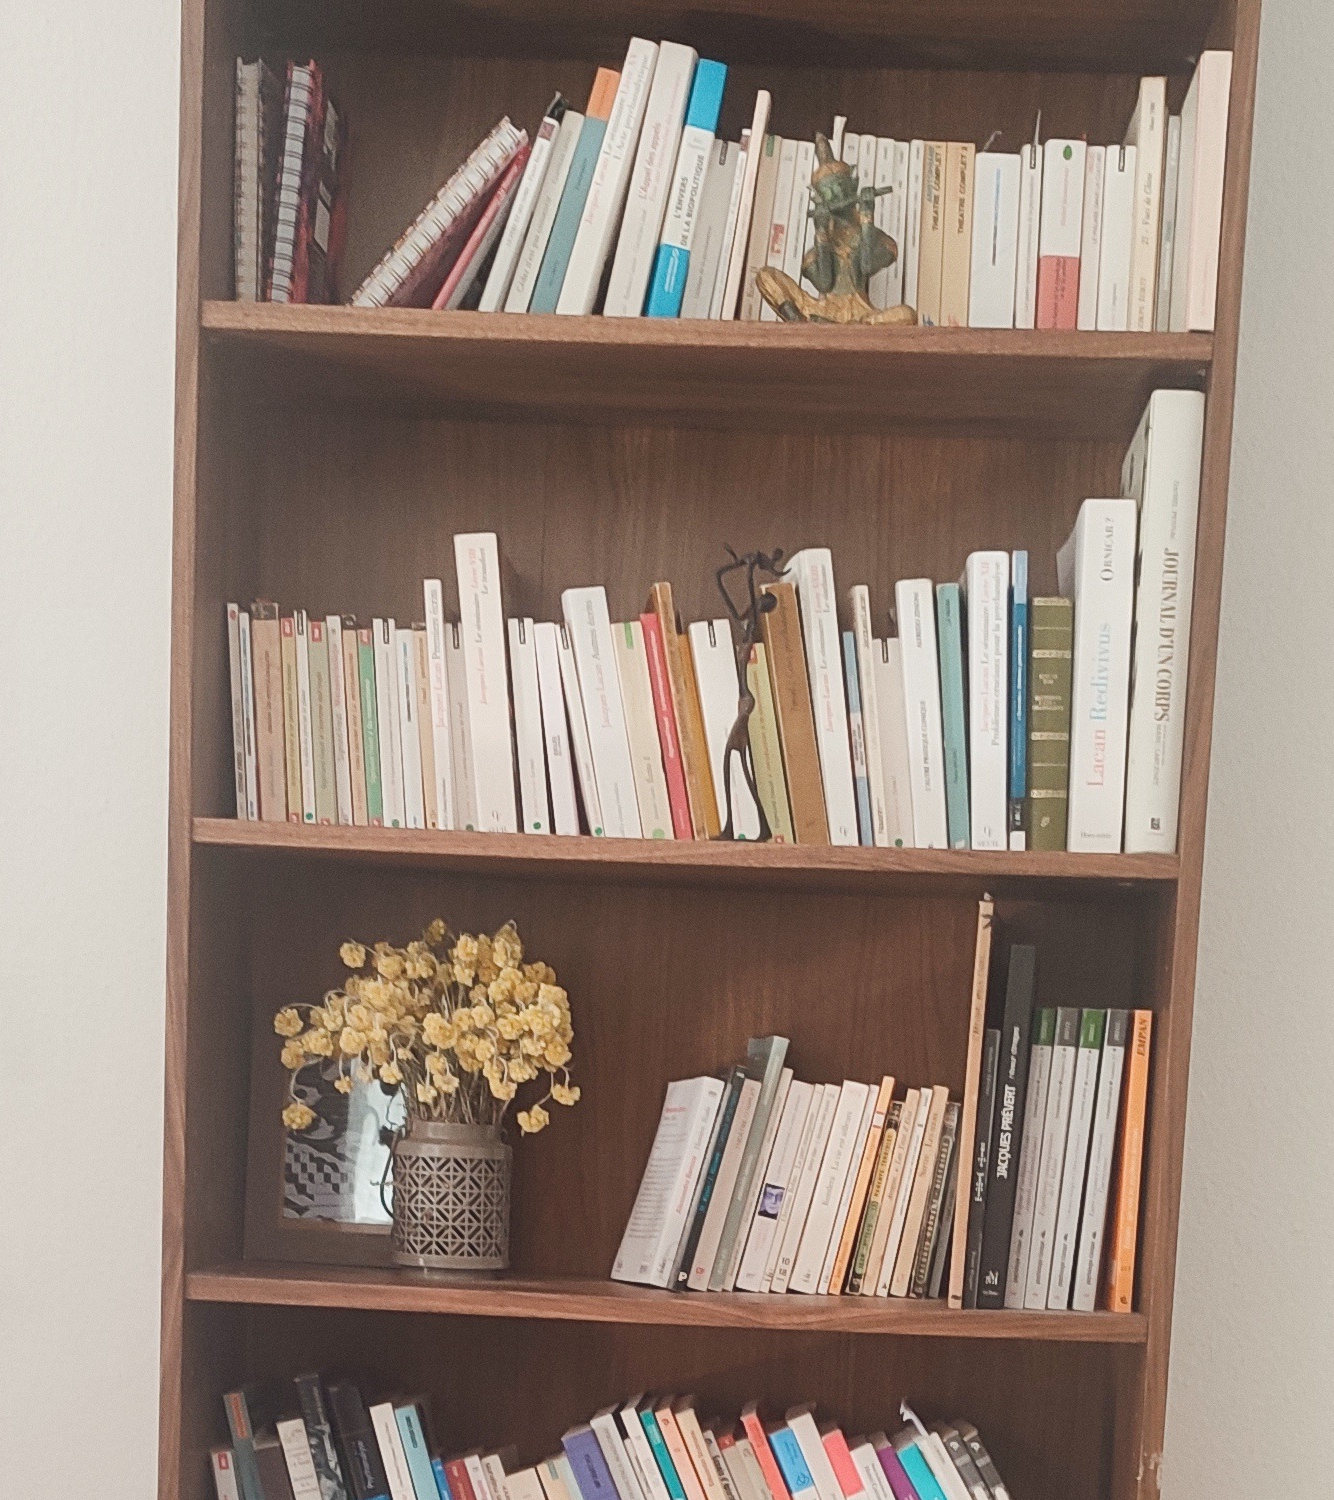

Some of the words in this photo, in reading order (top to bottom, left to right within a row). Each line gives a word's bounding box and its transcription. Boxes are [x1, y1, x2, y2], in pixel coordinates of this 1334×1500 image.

[673, 174, 688, 219] L'ENVERS
[685, 153, 704, 219] BIOPOLITIQUE
[680, 233, 688, 246] DE
[682, 219, 691, 233] LA
[1157, 547, 1182, 624] JOURNAL
[1155, 626, 1176, 666] D'UN
[1088, 621, 1110, 722] Redivivus
[1153, 668, 1173, 722] CORPS
[1085, 728, 1106, 789] Lacan
[1136, 1016, 1147, 1056] EMPAN
[998, 1083, 1017, 1131] PRÉVERT
[994, 1130, 1014, 1179] JACQUES
